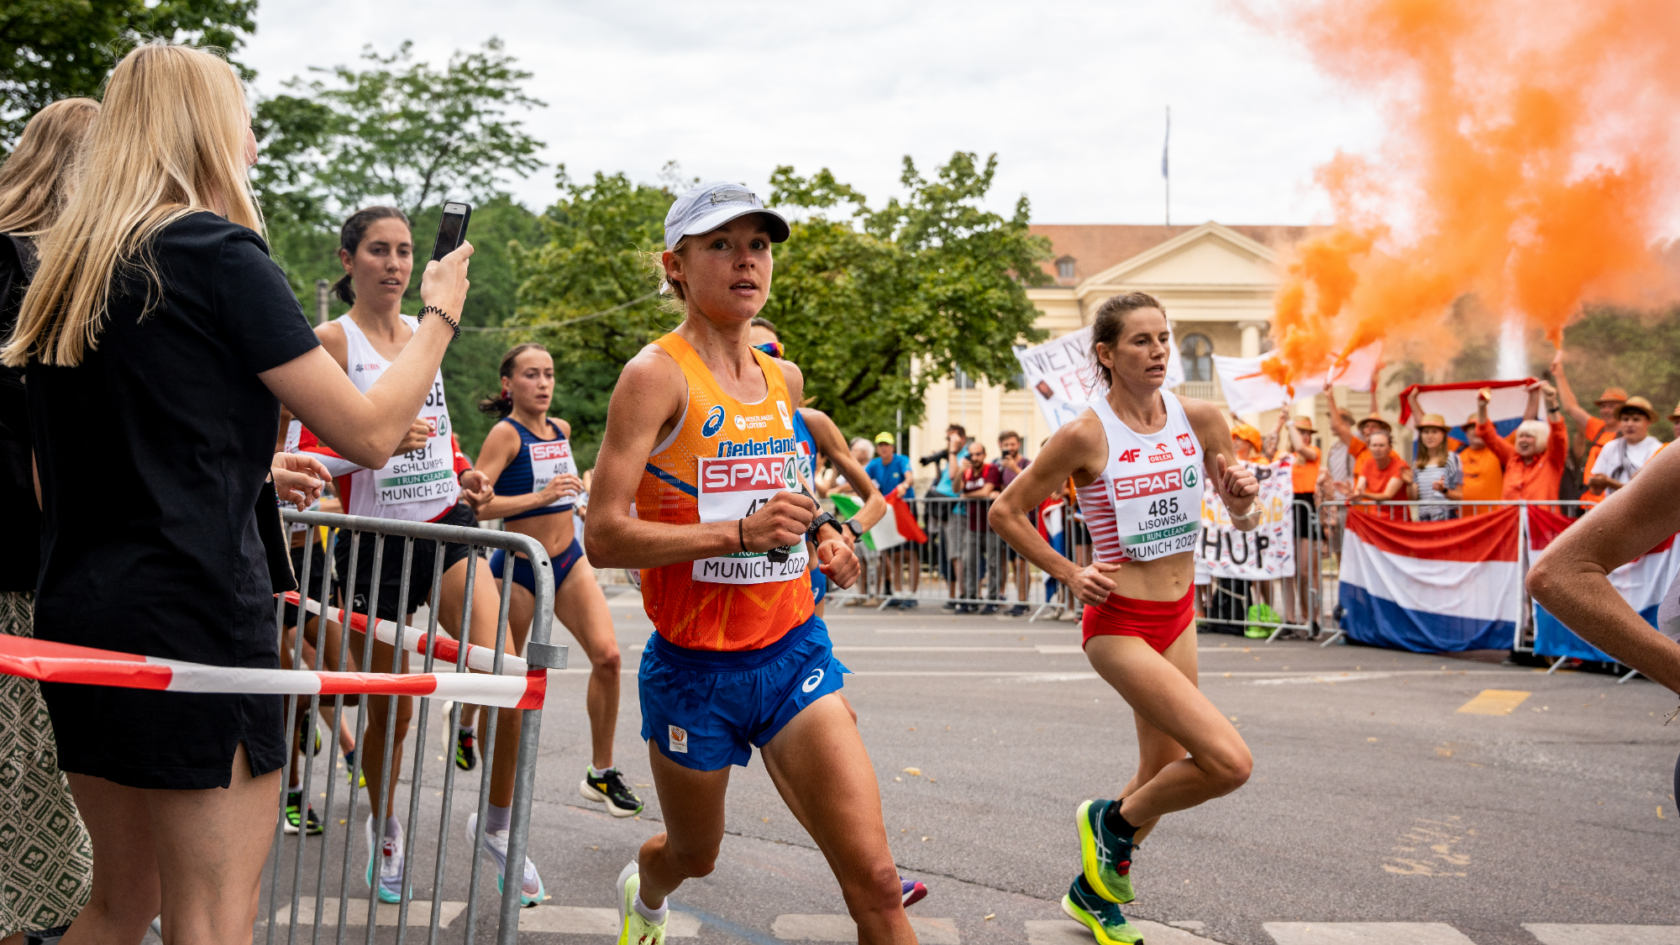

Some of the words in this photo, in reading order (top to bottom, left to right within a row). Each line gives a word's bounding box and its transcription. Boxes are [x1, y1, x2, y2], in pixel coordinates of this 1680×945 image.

[364, 363, 380, 371] UBS
[533, 444, 567, 460] SPAR
[1118, 448, 1141, 463] 4F
[1150, 453, 1172, 463] ORLEN
[393, 458, 443, 475] SCHLUMPF
[552, 462, 568, 475] 408
[705, 462, 784, 488] SPAR
[403, 475, 420, 484] RUN
[422, 471, 444, 482] CLEAN
[1115, 471, 1181, 497] SPAR
[381, 485, 432, 501] MUNICH
[435, 481, 453, 494] 202
[1148, 496, 1179, 517] 485
[1138, 512, 1188, 531] LISOWSKA
[1147, 530, 1162, 541] RUN
[1163, 525, 1185, 537] CLEAN
[1126, 540, 1172, 558] MUNICH
[1175, 533, 1197, 550] 2022
[1202, 526, 1269, 570] HUP
[703, 560, 774, 579] MUNICH
[780, 557, 805, 576] 2022
